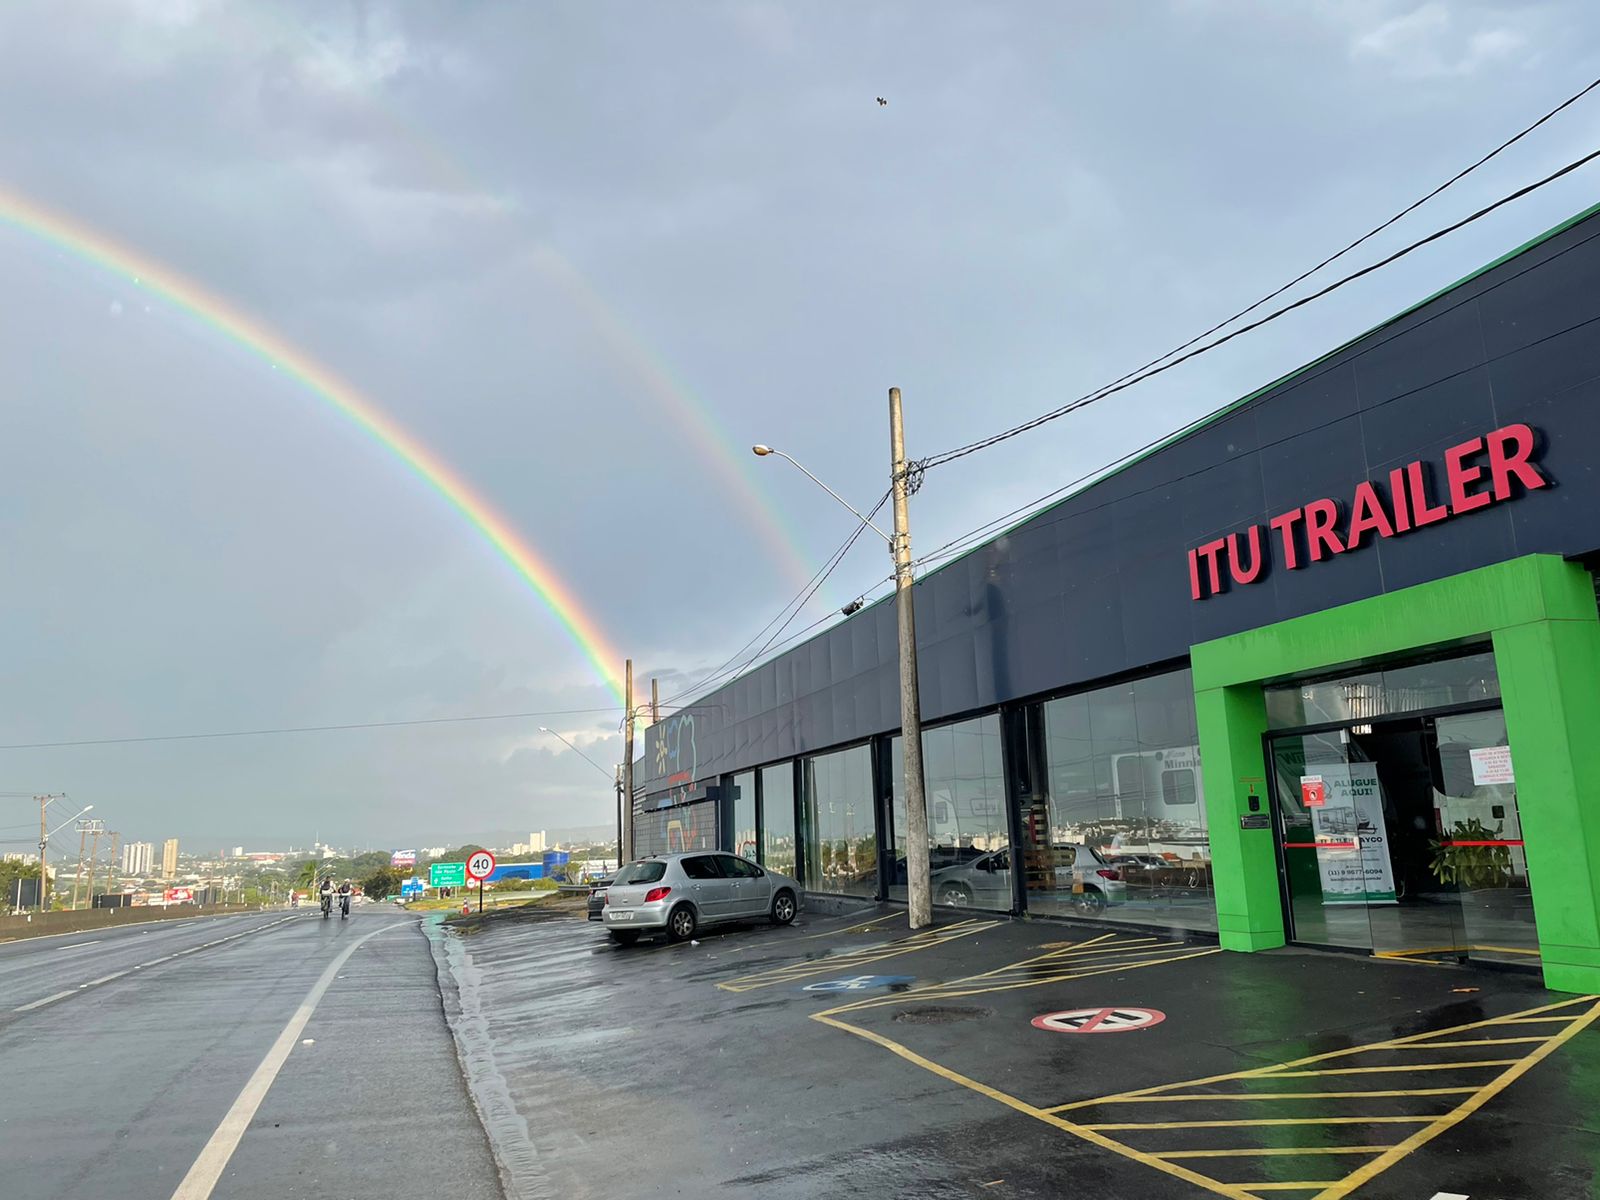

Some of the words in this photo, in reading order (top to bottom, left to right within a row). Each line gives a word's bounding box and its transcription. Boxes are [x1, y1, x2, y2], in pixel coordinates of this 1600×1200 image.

[1188, 524, 1263, 600] ITU
[1270, 423, 1547, 570] TRAILER
[1334, 778, 1377, 787] ALUGUE
[1341, 788, 1373, 797] AQUI!
[473, 859, 488, 870] 40
